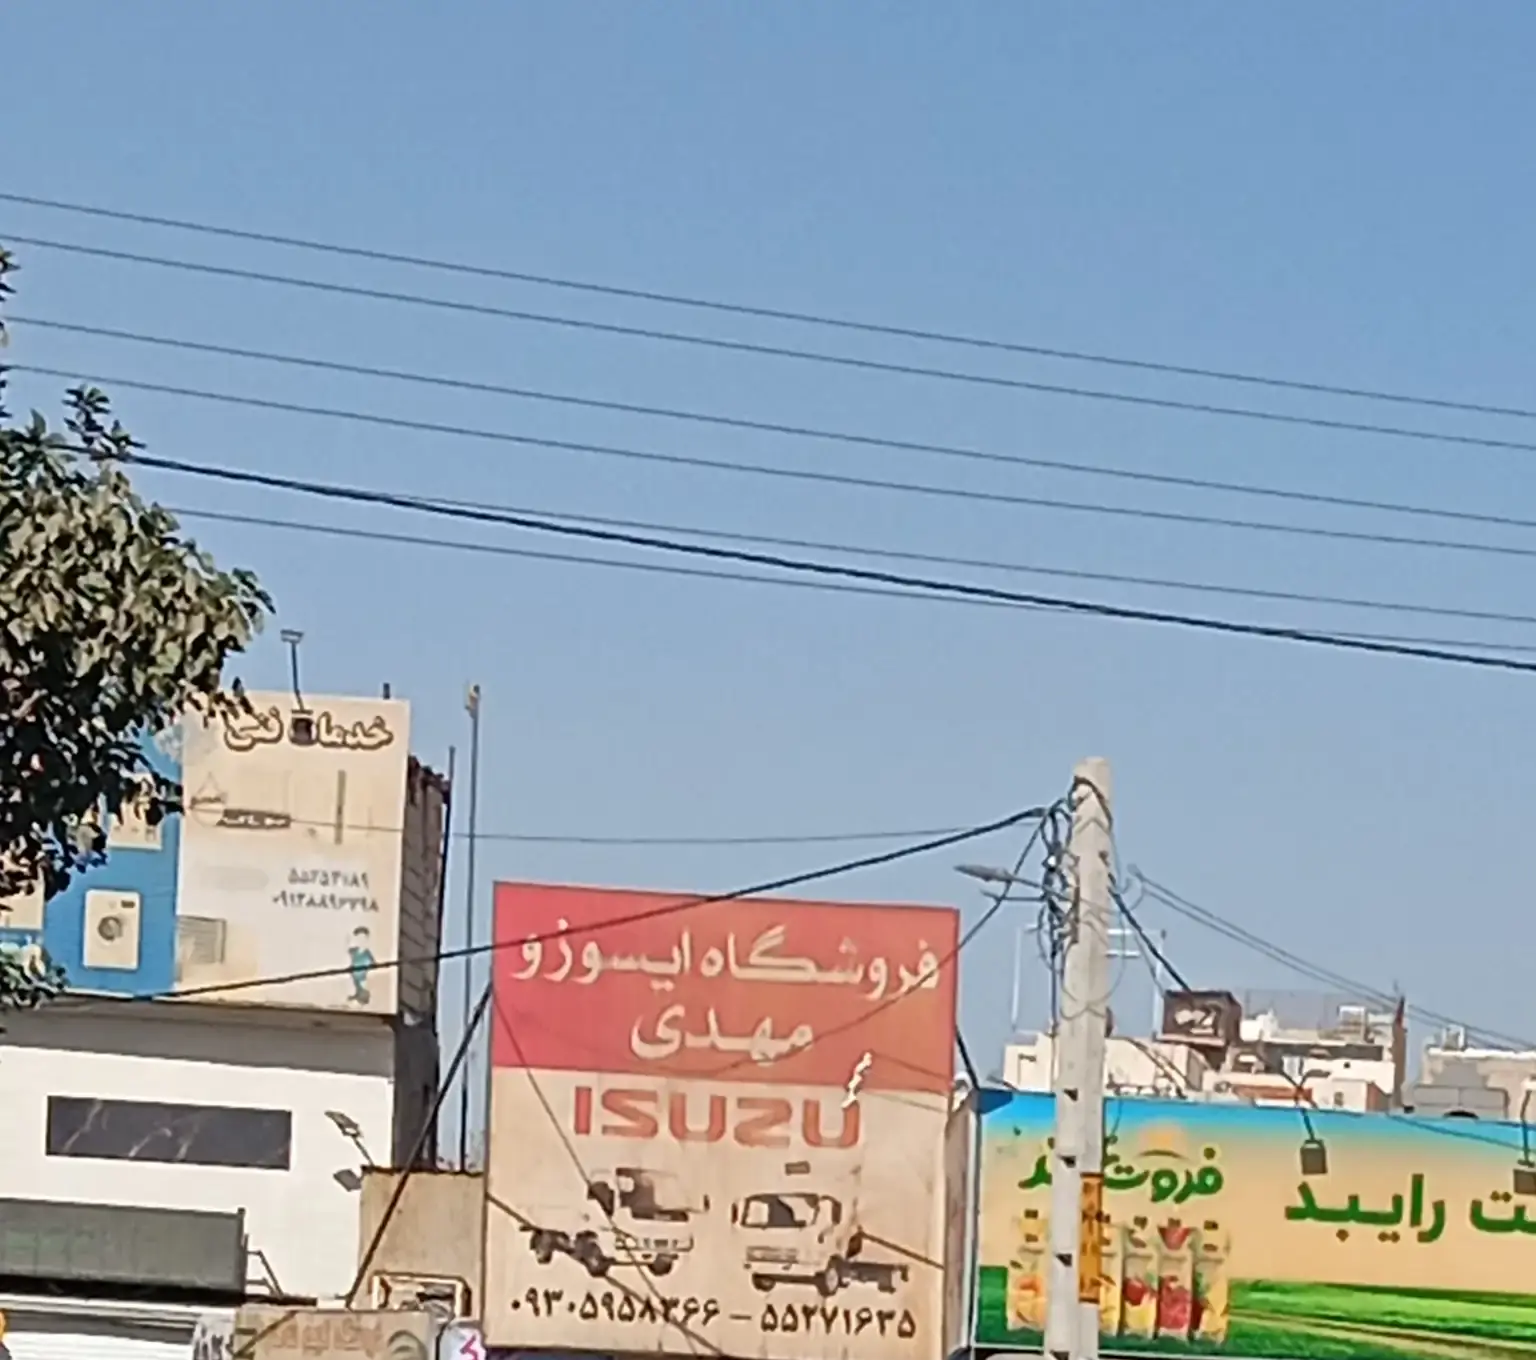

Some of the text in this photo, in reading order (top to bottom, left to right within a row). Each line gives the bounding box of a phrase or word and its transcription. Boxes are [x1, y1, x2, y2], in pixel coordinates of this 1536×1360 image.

[290, 711, 394, 751] خدما
[512, 918, 941, 1000] فروشگاه ایسوزو
[630, 1003, 814, 1067] مهدی
[574, 1086, 861, 1148] ISUZU
